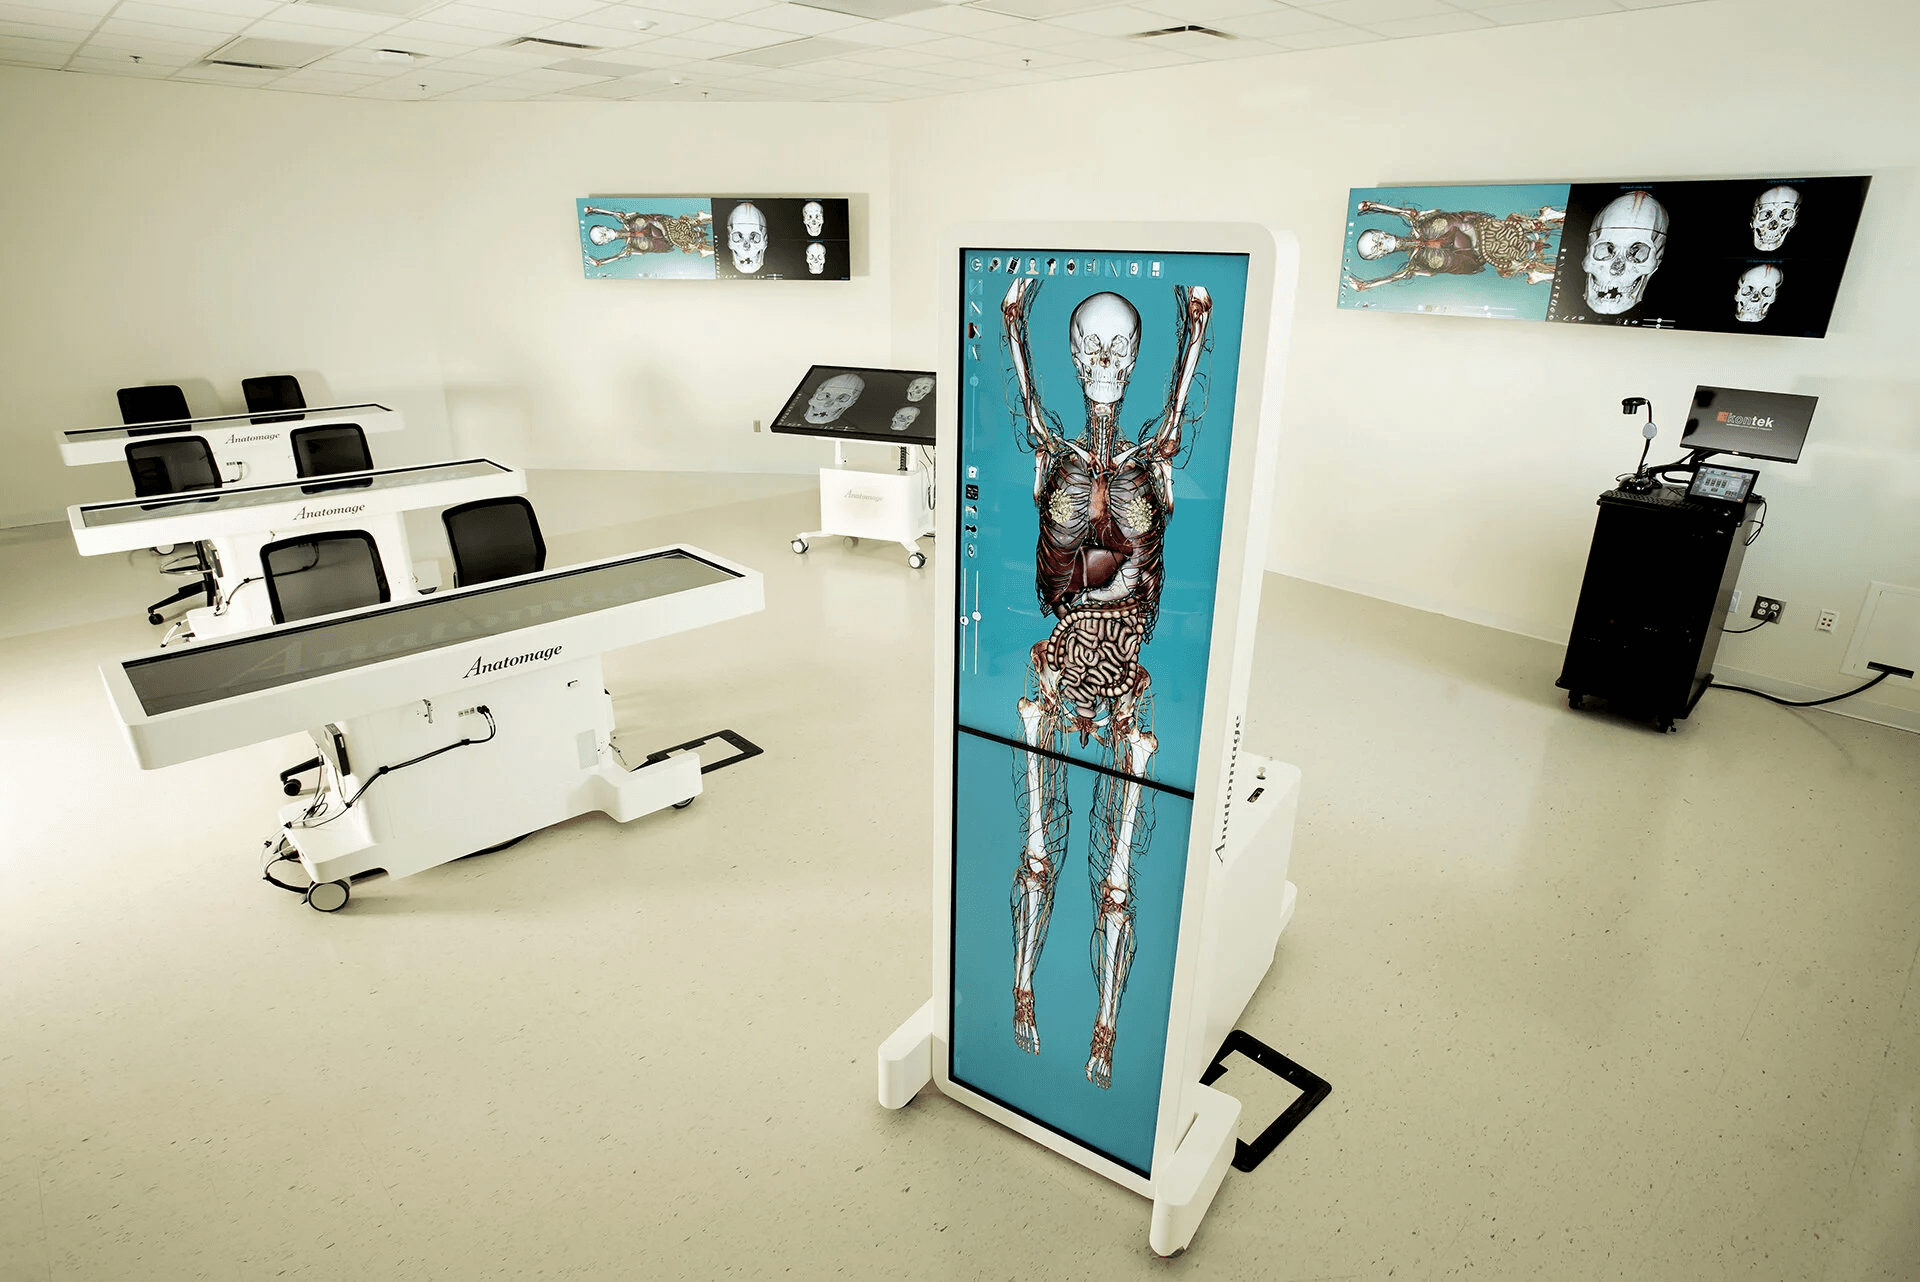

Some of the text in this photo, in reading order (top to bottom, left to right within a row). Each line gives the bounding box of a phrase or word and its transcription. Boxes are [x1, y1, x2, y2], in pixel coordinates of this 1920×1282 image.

[225, 433, 280, 444] Anatomage
[293, 504, 366, 520] Anatomage
[462, 645, 562, 679] Anatomage
[1215, 715, 1241, 864] Anatomage
